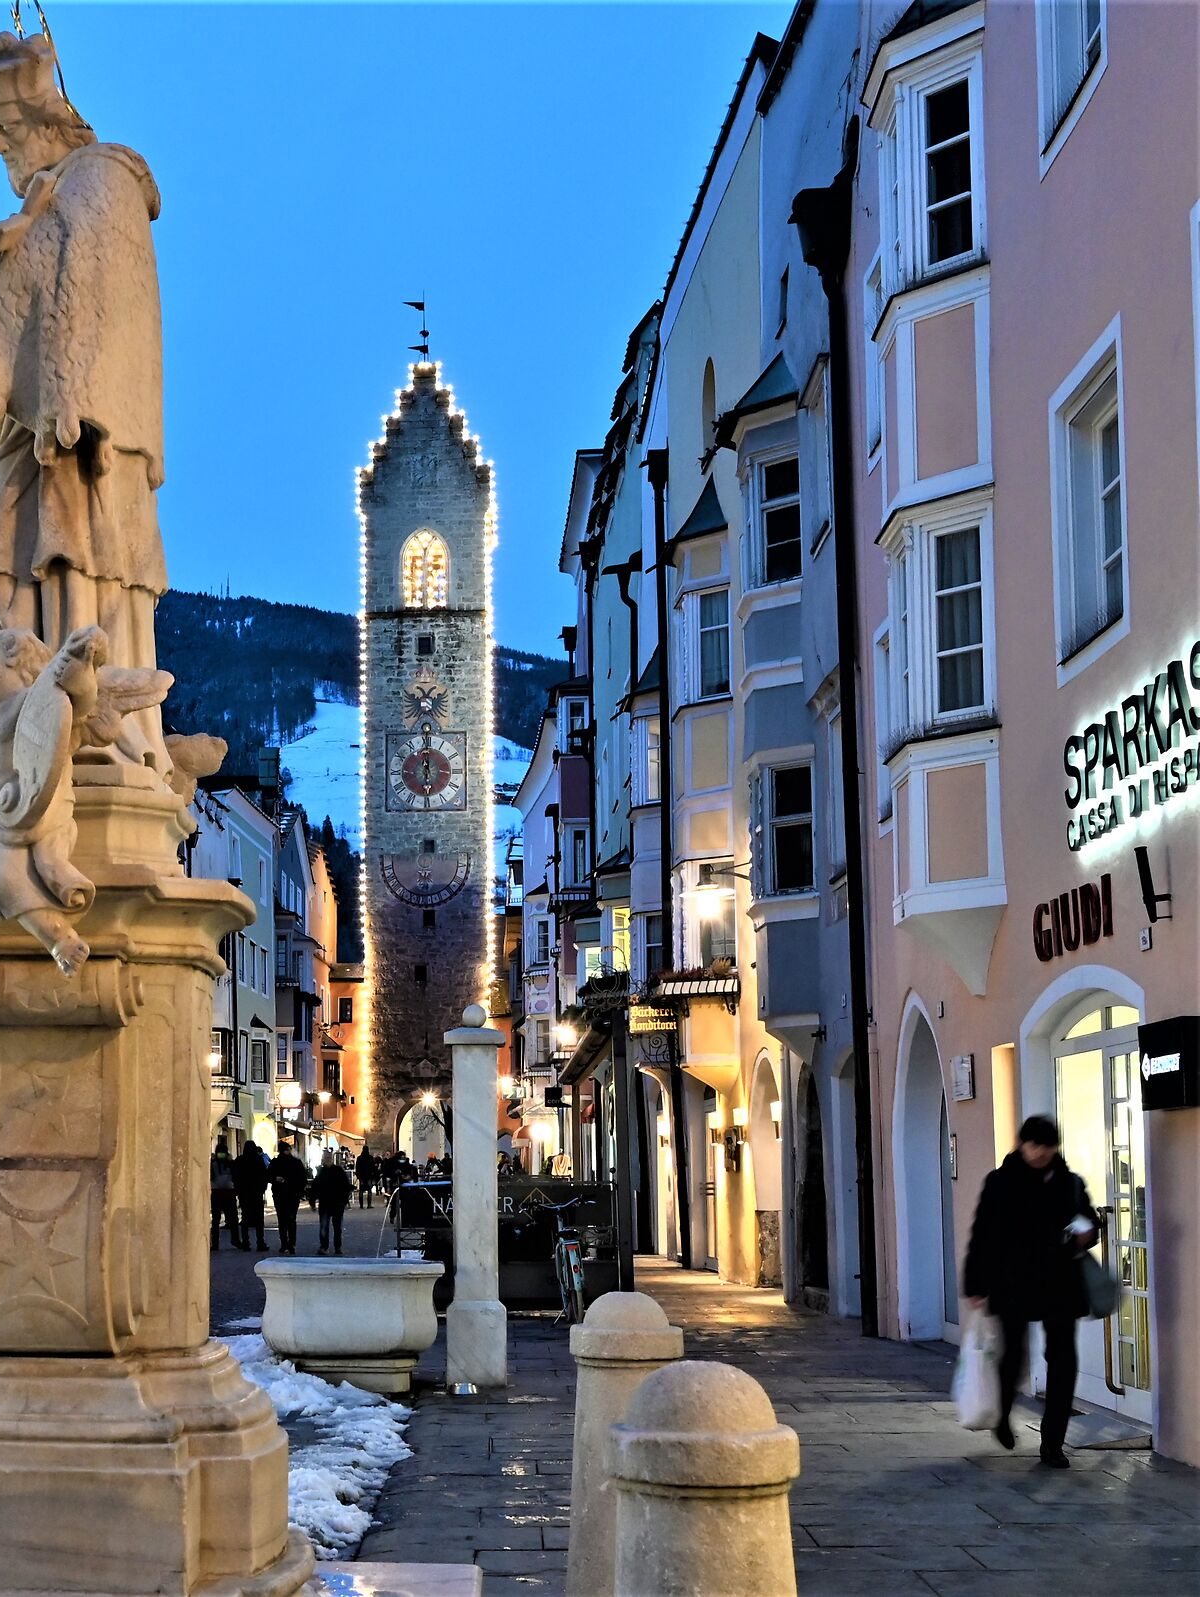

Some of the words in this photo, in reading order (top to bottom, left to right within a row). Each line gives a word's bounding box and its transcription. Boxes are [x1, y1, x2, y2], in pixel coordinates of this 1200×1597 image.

[1066, 795, 1125, 852] CASSA
[1128, 779, 1150, 818] DI
[1153, 740, 1200, 806] RISP
[1032, 873, 1114, 962] GIUDI
